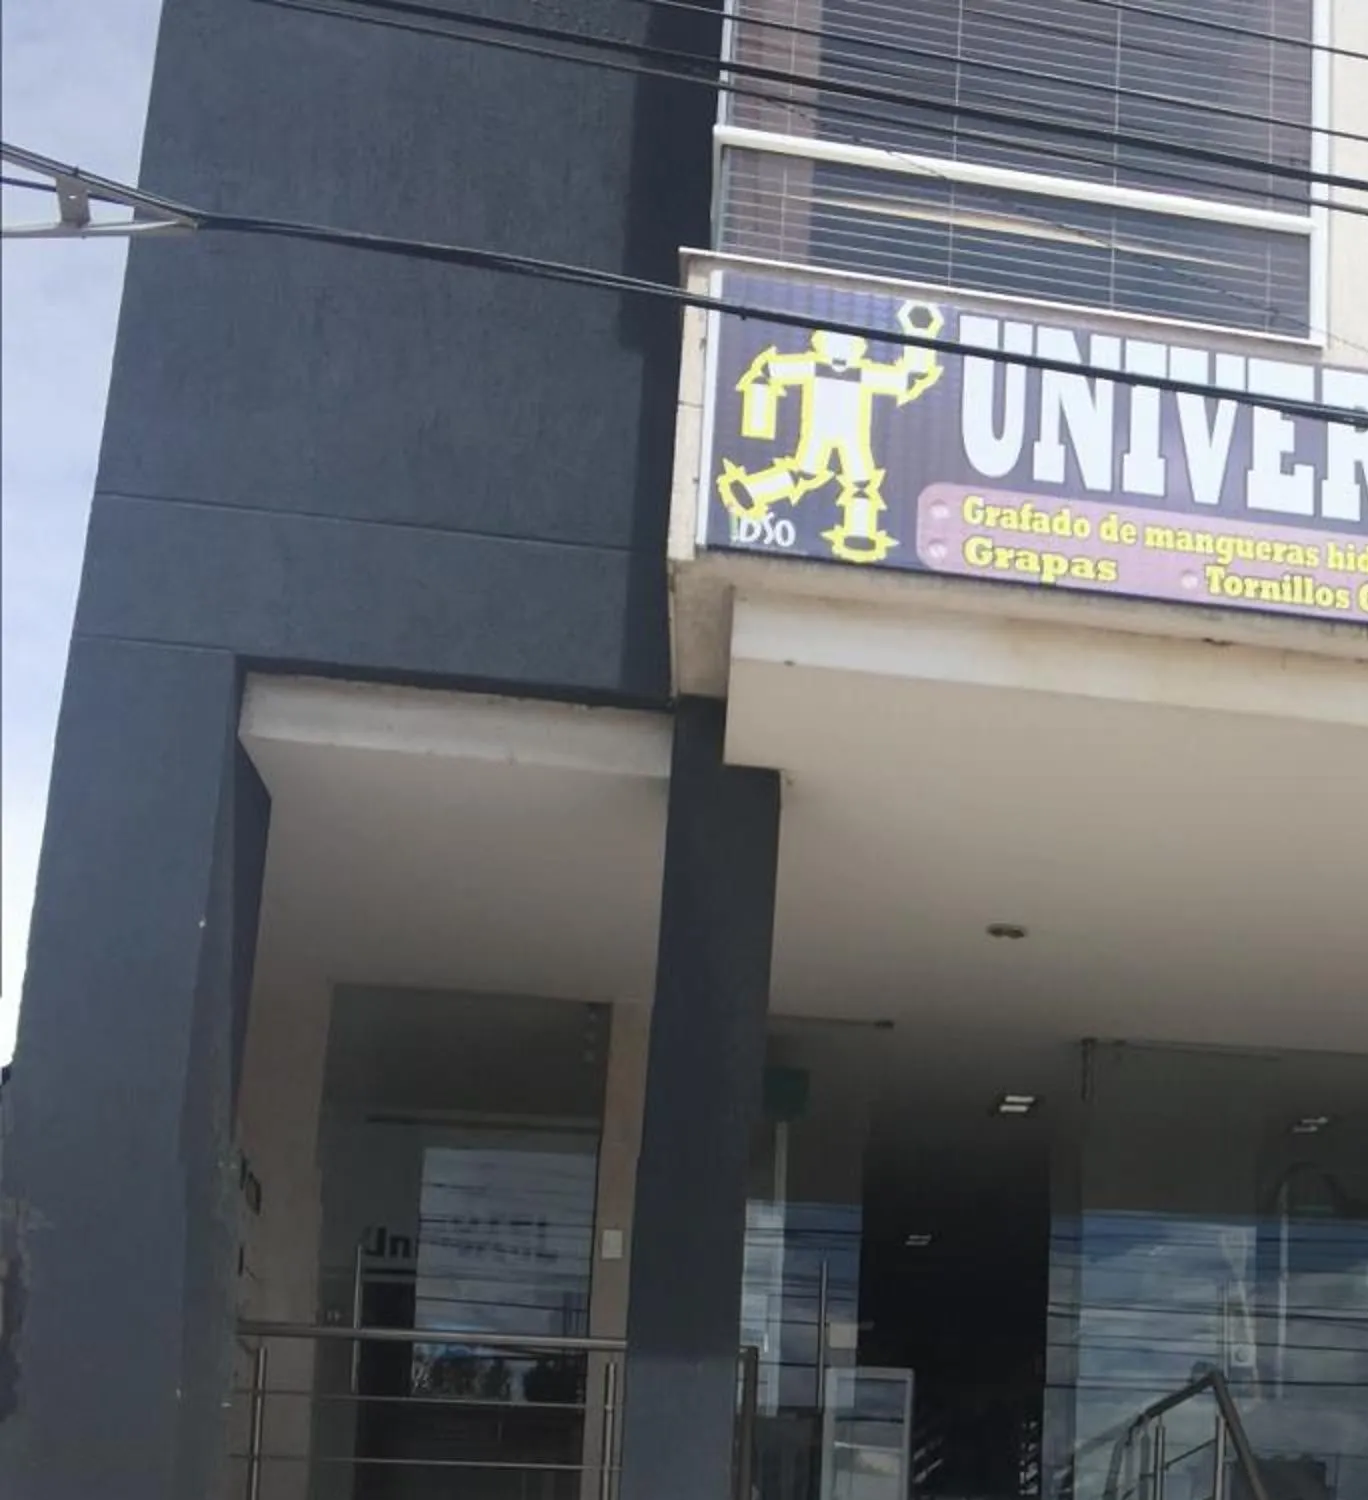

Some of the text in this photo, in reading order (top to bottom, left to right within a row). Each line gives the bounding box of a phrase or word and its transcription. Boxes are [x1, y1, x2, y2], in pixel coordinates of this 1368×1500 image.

[962, 495, 1090, 541] Grafado
[1100, 508, 1136, 547] de
[1144, 525, 1319, 573] mangueras
[962, 536, 1117, 585] Grapas
[1205, 565, 1349, 610] Tornillos
